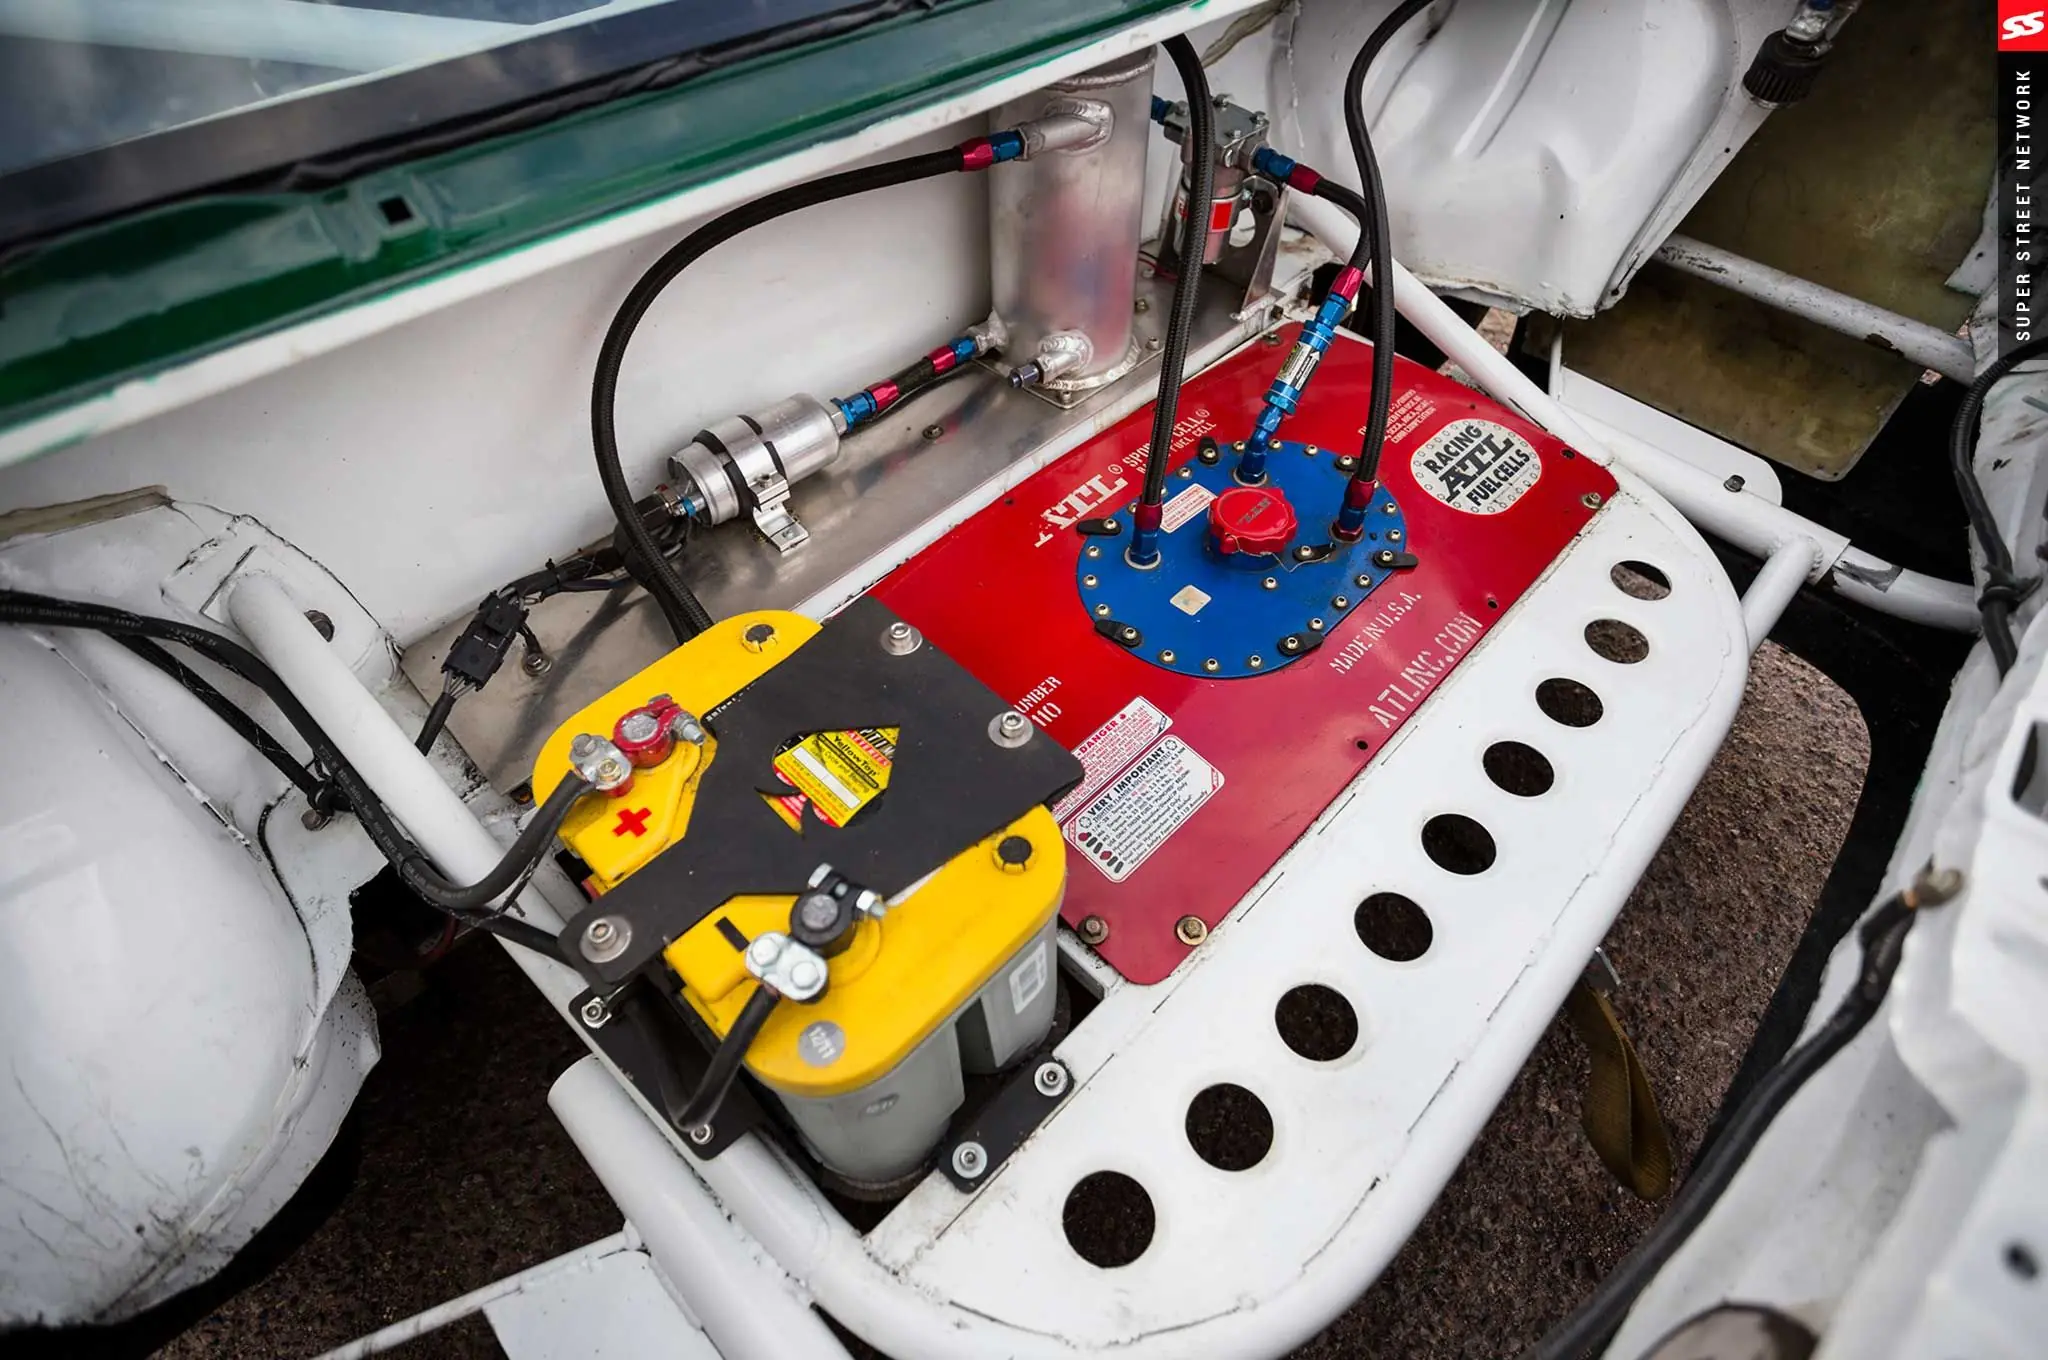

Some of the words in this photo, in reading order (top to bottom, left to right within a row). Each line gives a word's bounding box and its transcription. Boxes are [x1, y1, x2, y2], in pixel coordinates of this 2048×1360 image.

[1173, 416, 1205, 437] CELL
[1192, 421, 1217, 437] CELL
[1423, 425, 1482, 474] RACING
[1438, 433, 1514, 503] ATL
[1329, 635, 1372, 675] MADE
[1363, 622, 1386, 642] IN
[1014, 676, 1062, 714] UMBER
[1078, 719, 1119, 753] DANGER
[1086, 792, 1114, 817] VERY
[1112, 746, 1166, 793] IMPORTANT
[1092, 802, 1115, 823] TIGHTEN
[1111, 786, 1132, 805] FLANGE
[1130, 773, 1147, 788] BOLTS
